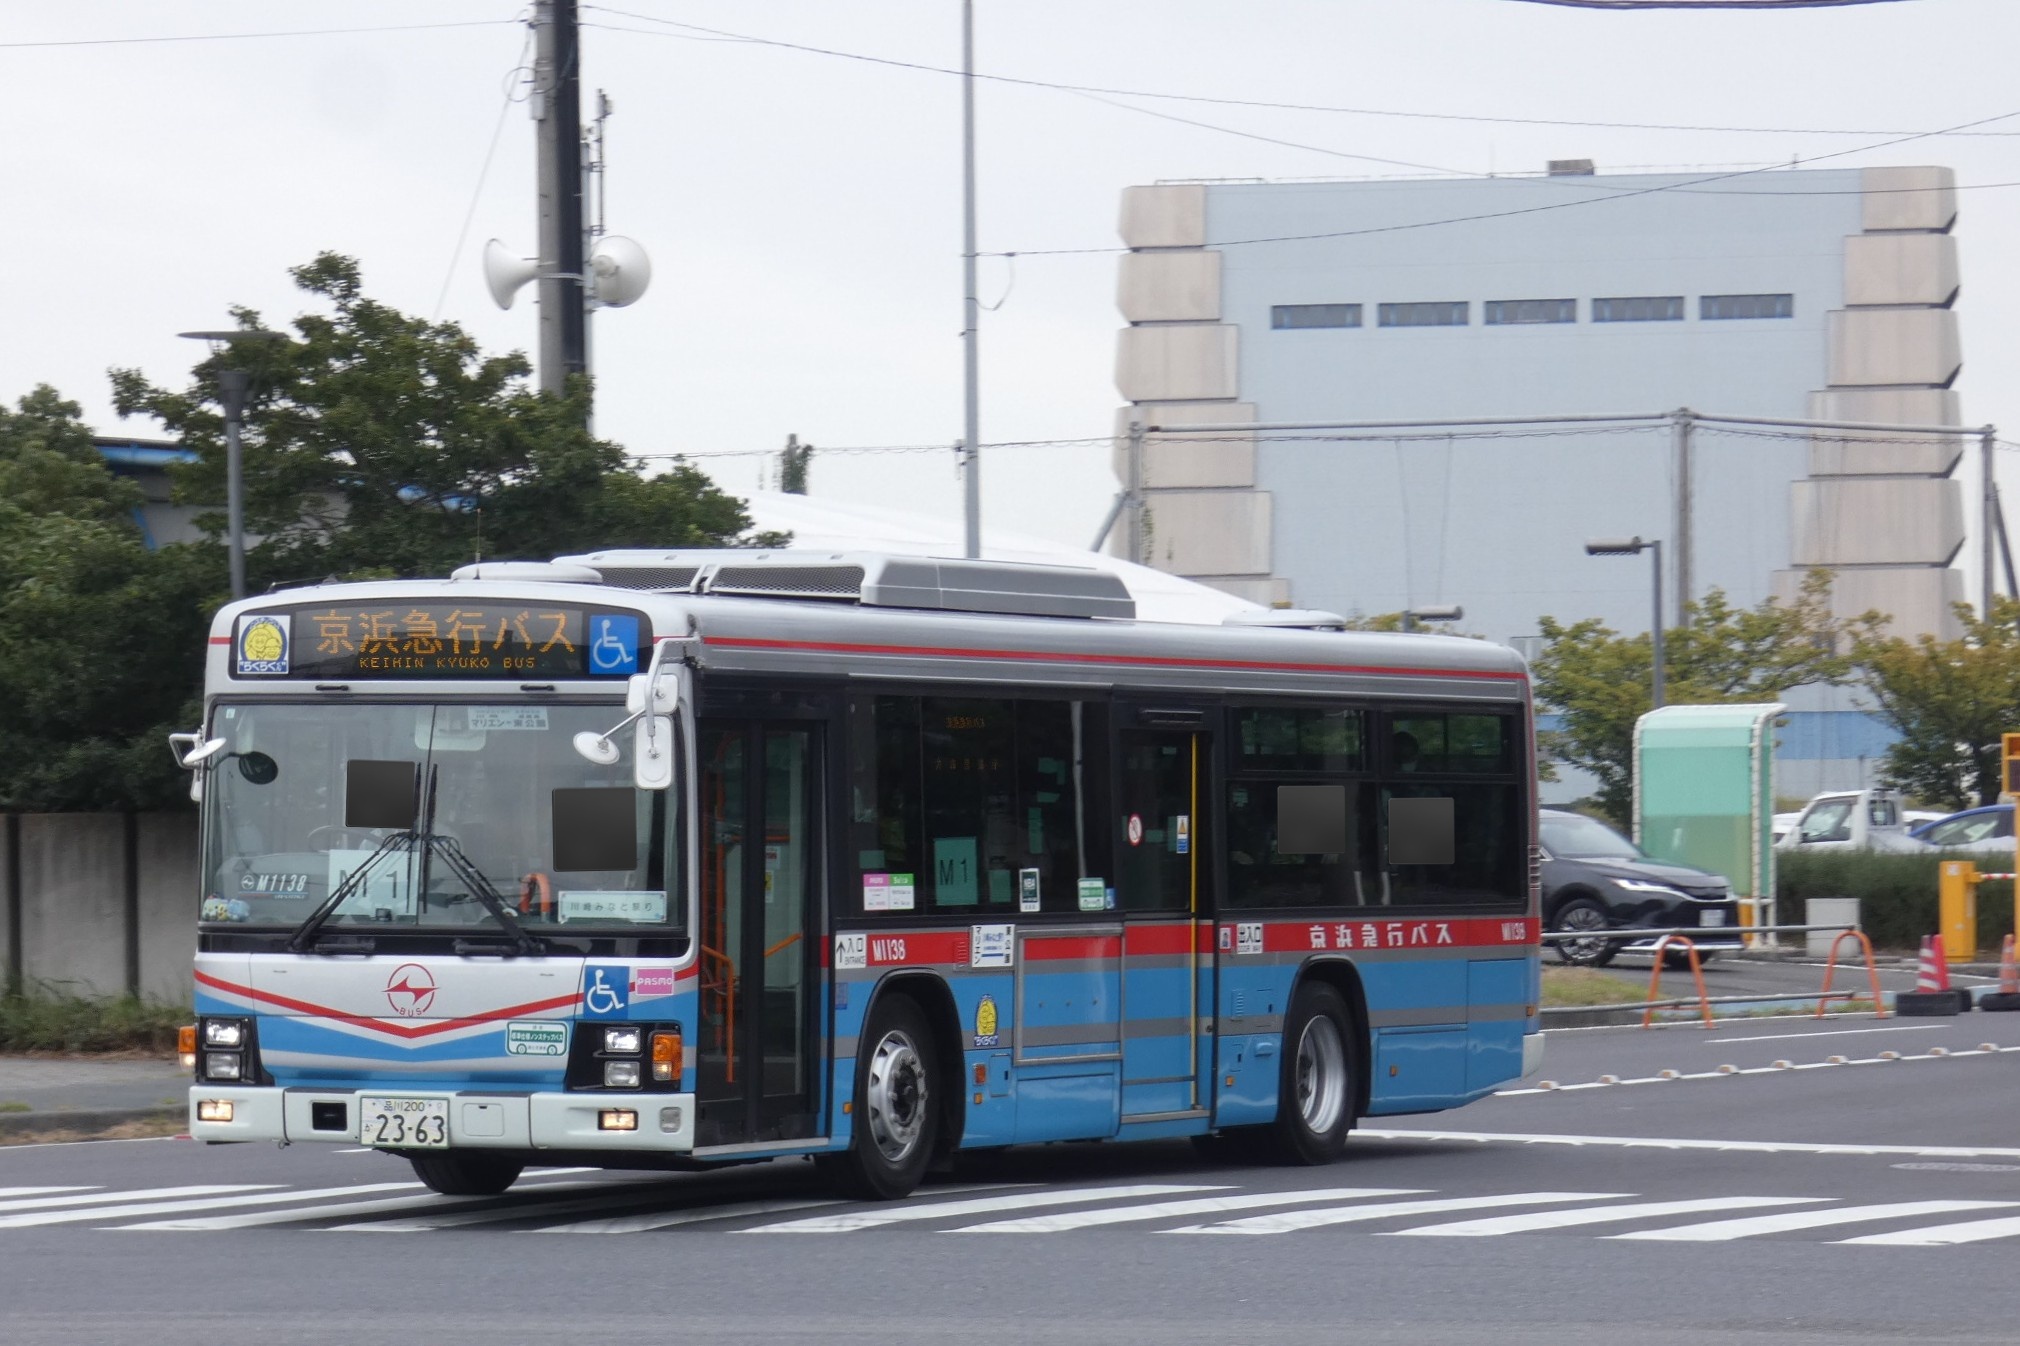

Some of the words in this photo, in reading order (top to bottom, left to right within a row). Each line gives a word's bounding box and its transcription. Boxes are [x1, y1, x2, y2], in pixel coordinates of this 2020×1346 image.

[312, 609, 576, 655] 京浜急行バス
[360, 657, 424, 669] KEIHIN
[437, 657, 490, 669] KYUKO
[503, 657, 536, 669] BUS
[256, 874, 308, 892] M1138
[1309, 923, 1452, 949] 京浜急行バス
[872, 939, 906, 961] M1138
[637, 977, 673, 986] PASMO
[399, 1006, 422, 1018] BUS
[376, 1113, 445, 1144] 23-63
